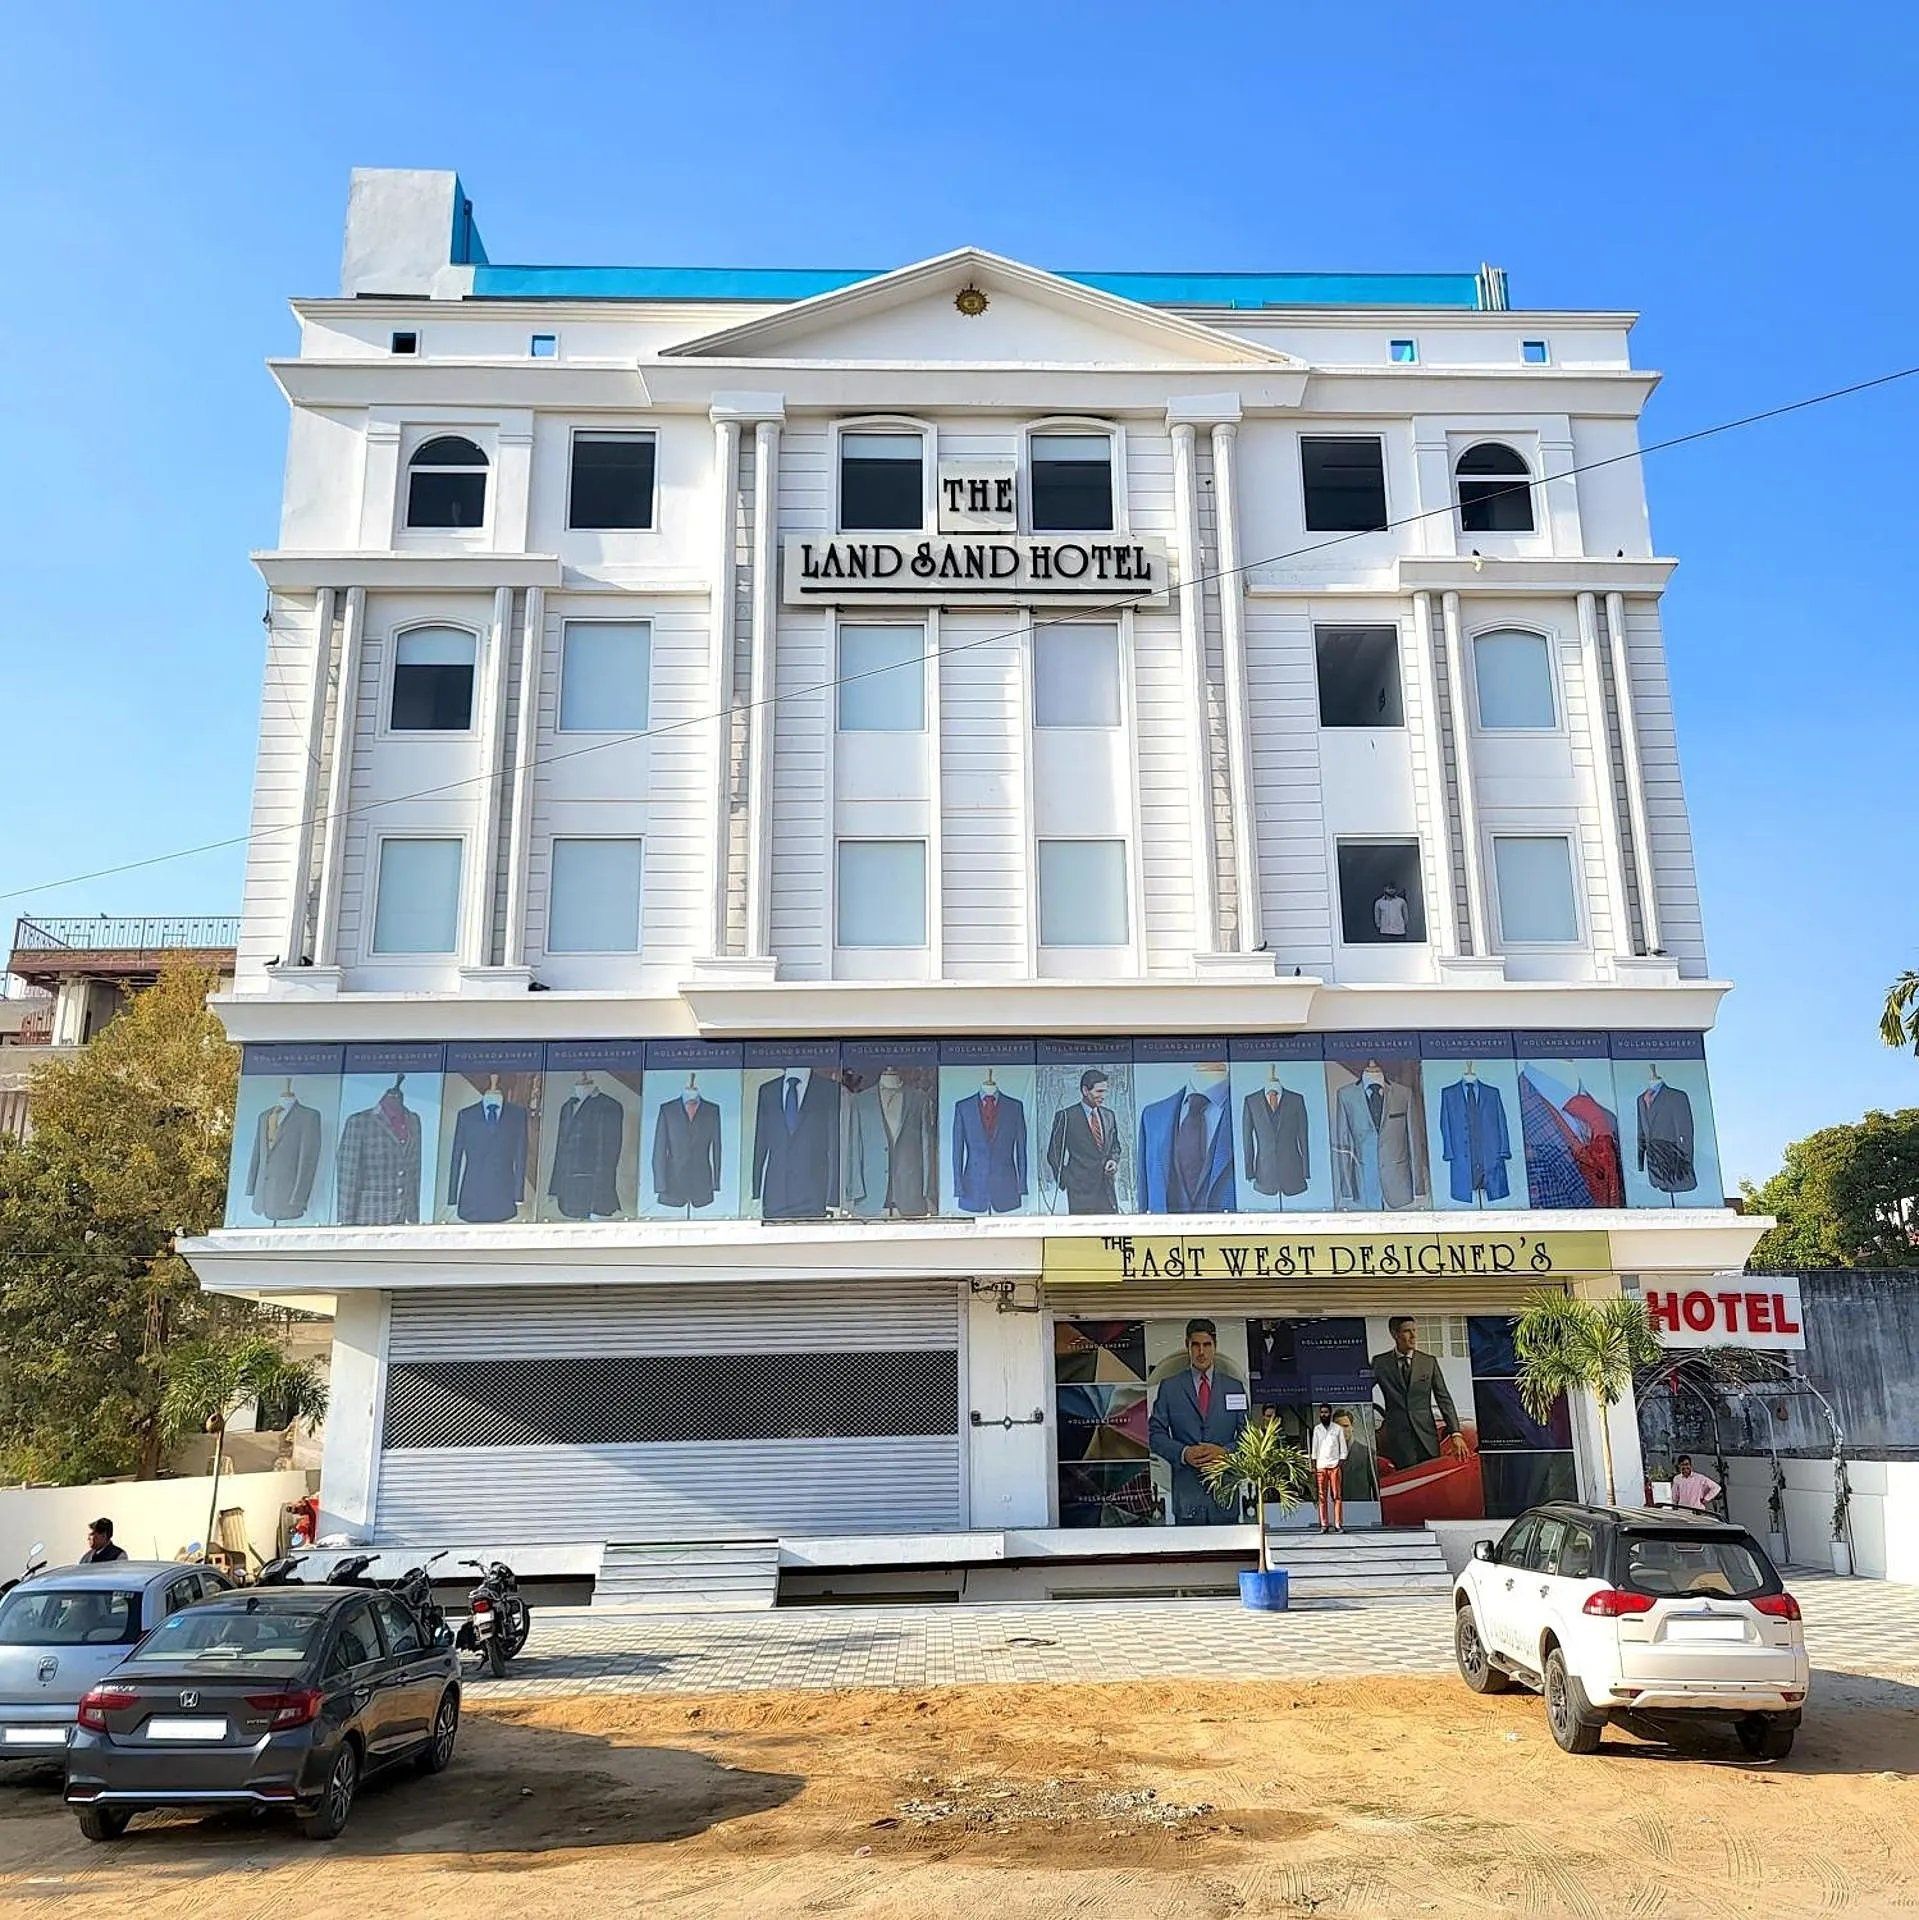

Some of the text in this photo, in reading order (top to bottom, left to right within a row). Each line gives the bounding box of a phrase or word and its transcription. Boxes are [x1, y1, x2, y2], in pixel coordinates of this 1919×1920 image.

[943, 478, 1012, 512] THE
[801, 541, 1152, 580] LAND SAND HOTEL
[1101, 1236, 1133, 1250] THE
[1121, 1236, 1553, 1278] EAST WEST DESIGNER'S
[1647, 1291, 1799, 1334] HOTEL
